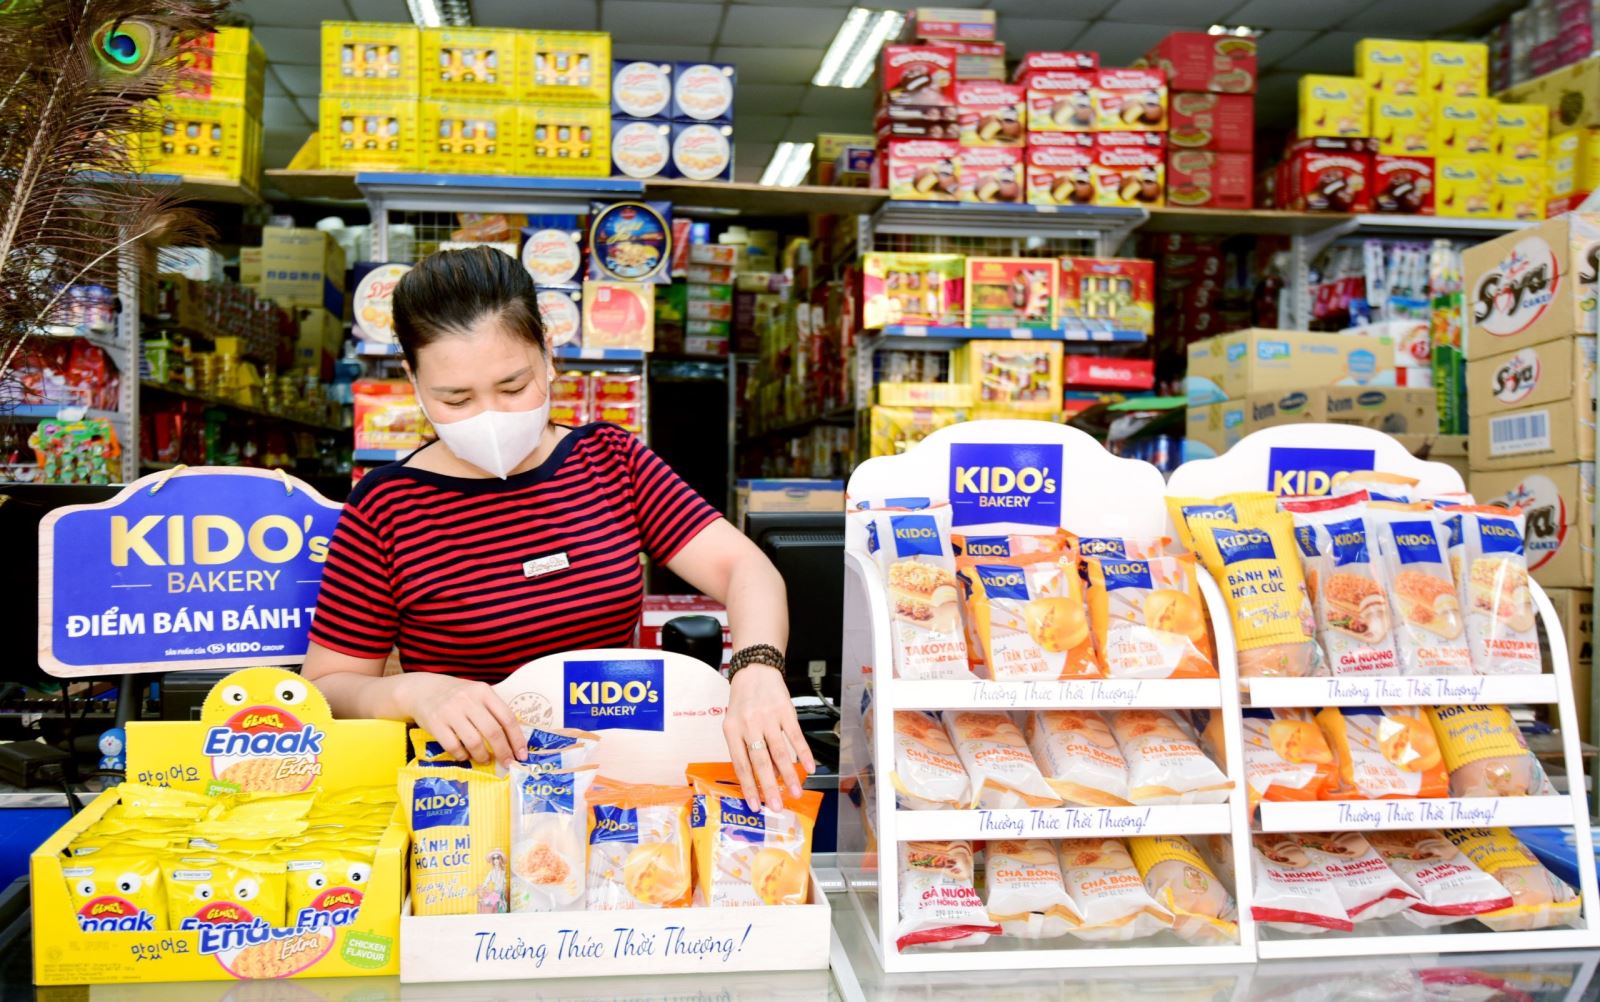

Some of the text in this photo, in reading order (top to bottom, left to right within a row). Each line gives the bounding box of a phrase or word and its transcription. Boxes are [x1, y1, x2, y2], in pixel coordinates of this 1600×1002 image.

[955, 466, 1056, 495] KIDO's
[979, 496, 1031, 508] BAKERY
[110, 515, 330, 567] KIDO's
[896, 528, 937, 539] KIDO's
[1397, 534, 1436, 546] KIDO's
[968, 545, 1008, 555] KIDO's
[1105, 563, 1148, 575] KIDO's
[167, 569, 281, 594] BAKERY
[982, 574, 1025, 587] KIDO's
[1231, 581, 1286, 599] HOA CÚC
[65, 606, 146, 637] ĐIỂM
[153, 607, 214, 634] BÁN
[222, 605, 301, 631] BÁNH
[226, 642, 261, 653] KIDO
[261, 644, 285, 652] GROUP
[569, 681, 659, 705] KIDO's
[591, 705, 637, 717] BAKERY
[1437, 705, 1464, 720] HOA
[242, 713, 285, 729] GEMEZ
[204, 724, 325, 755] Enaak
[275, 757, 322, 780] Extra
[525, 784, 572, 796] KIDO's
[415, 794, 466, 812] KIDO's
[723, 812, 764, 828] KIDO's
[1065, 809, 1093, 830] Thời
[414, 834, 471, 855] BÁNH MÌ
[416, 852, 470, 869] HOA CÚC
[922, 886, 939, 900] GÀ
[78, 910, 155, 931] naak
[131, 937, 190, 962] 맛있어요
[281, 937, 318, 961] Extra
[349, 938, 386, 951] CHICKEN
[474, 923, 753, 968] Thưởng Thức Thời Thượng!
[346, 948, 386, 961] FLAVOUR
